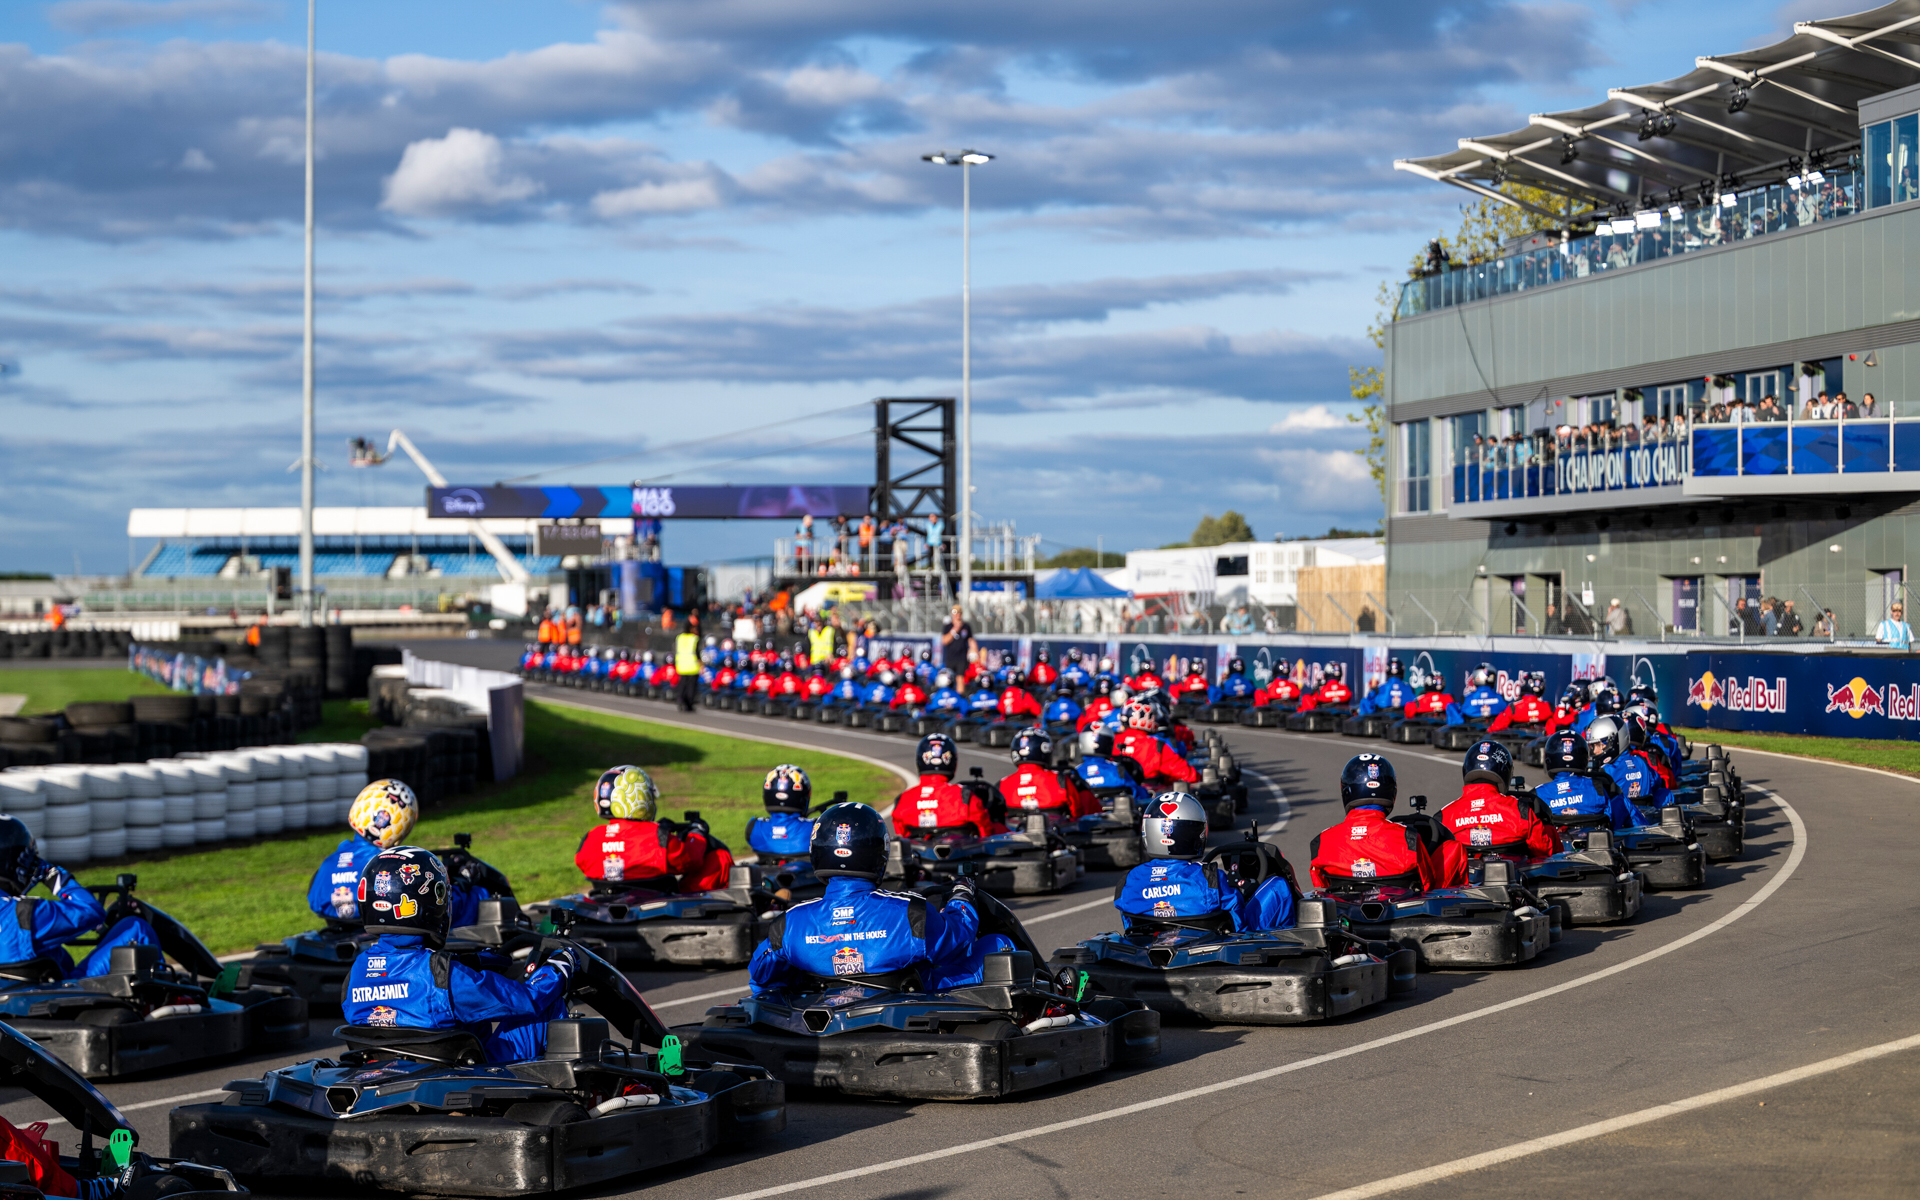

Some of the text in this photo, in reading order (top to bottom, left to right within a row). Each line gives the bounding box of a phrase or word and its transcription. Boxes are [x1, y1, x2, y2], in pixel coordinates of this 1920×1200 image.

[1566, 452, 1623, 491] CHAMPON
[633, 488, 672, 500] MAX
[1728, 676, 1787, 713] Red Bull
[1888, 683, 1917, 720] Red
[1550, 795, 1584, 808] GABS DJAY
[1455, 813, 1503, 827] KAROL ZDĘBA
[1351, 827, 1367, 835] OMP
[602, 841, 625, 853] DOYLE
[1151, 868, 1167, 876] OMP
[1142, 884, 1181, 899] CARLSON
[832, 908, 855, 918] OMP
[805, 935, 819, 944] BEST
[844, 932, 852, 942] IN
[853, 931, 865, 941] THE
[865, 929, 887, 940] HOUSE
[367, 958, 387, 969] OMP
[848, 955, 861, 963] Bull
[836, 963, 861, 976] MAX
[352, 983, 409, 1003] EXTRAEMILY
